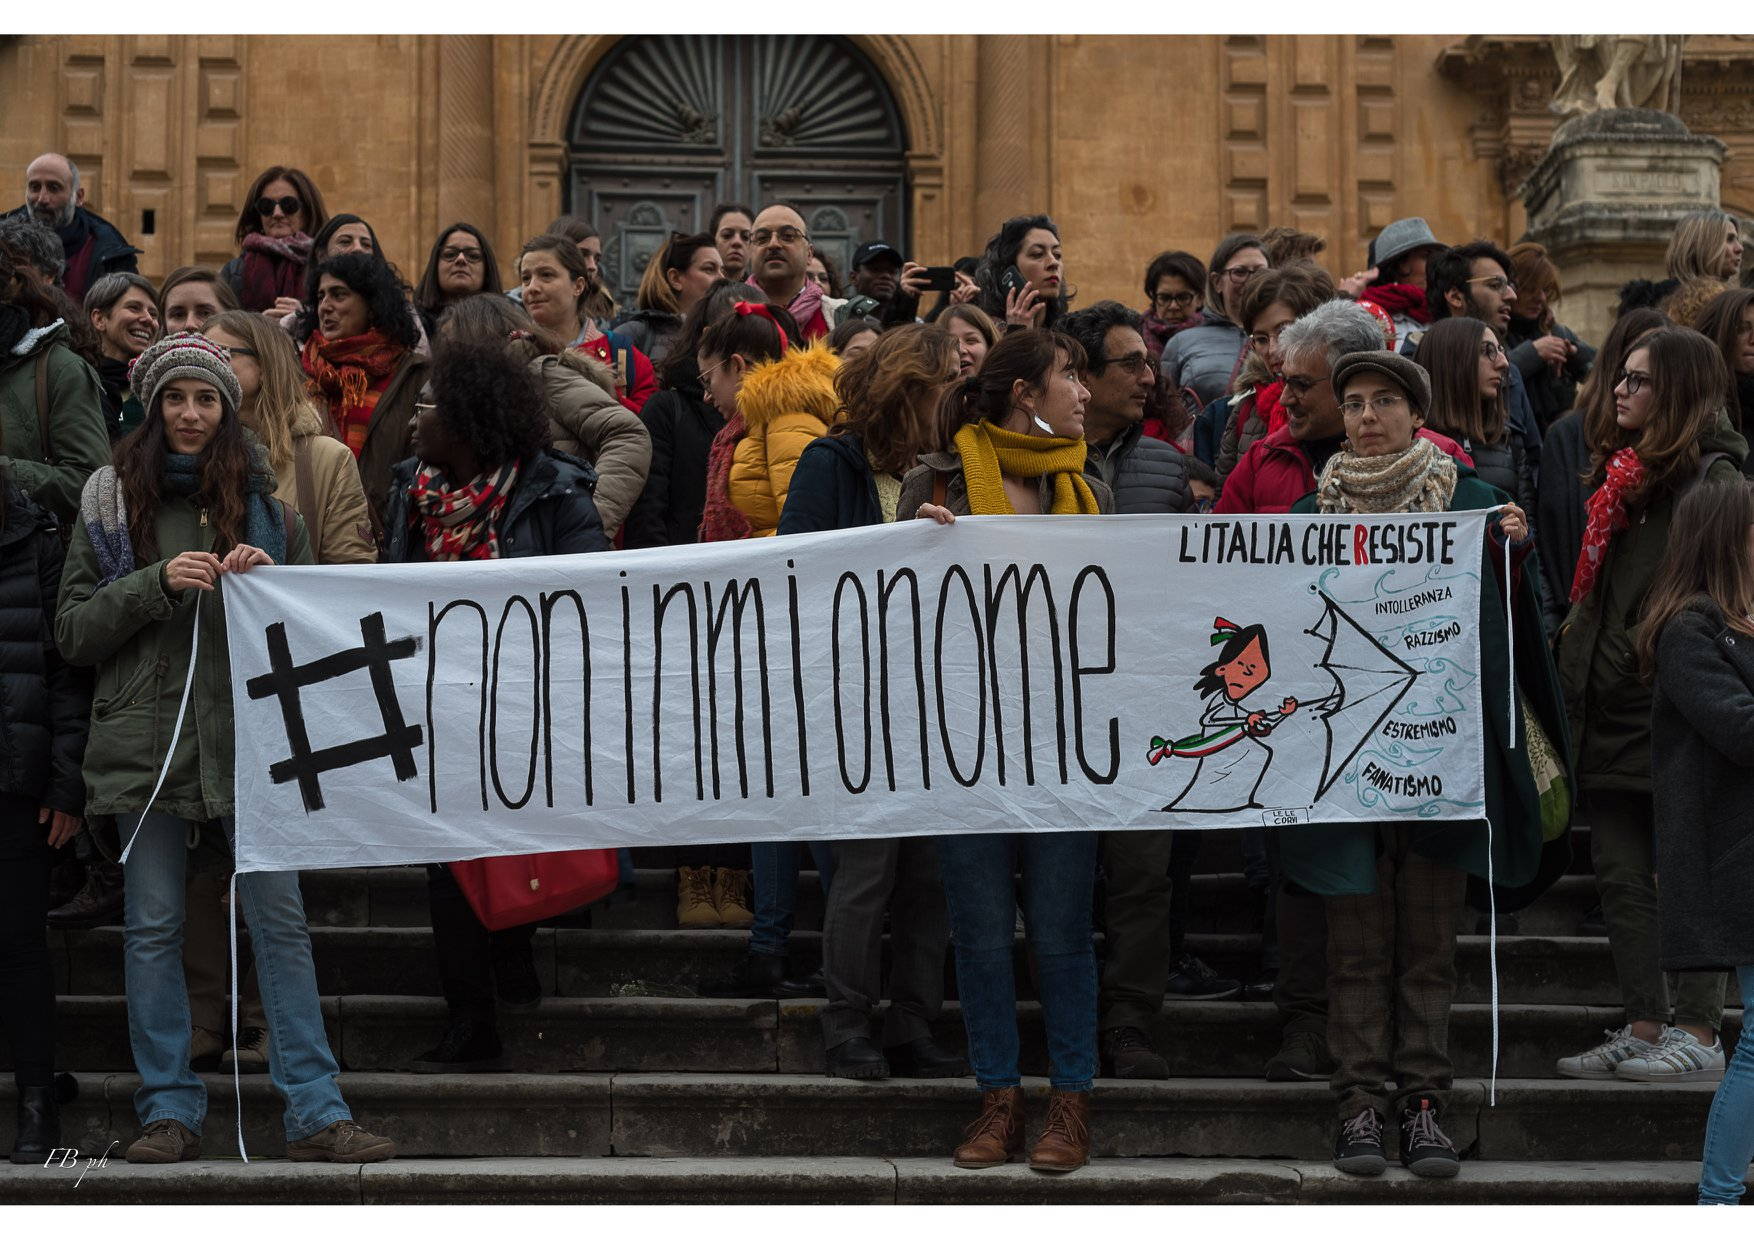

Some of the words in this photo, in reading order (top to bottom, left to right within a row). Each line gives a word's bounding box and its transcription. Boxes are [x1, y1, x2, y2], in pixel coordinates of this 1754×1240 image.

[1178, 521, 1295, 564] L'ITALIA
[1374, 586, 1453, 615] INTOLLERANZA
[1403, 621, 1461, 650] RAZZISMO
[1381, 717, 1457, 741] ESTREMISMO
[1361, 761, 1443, 797] FANATISMO
